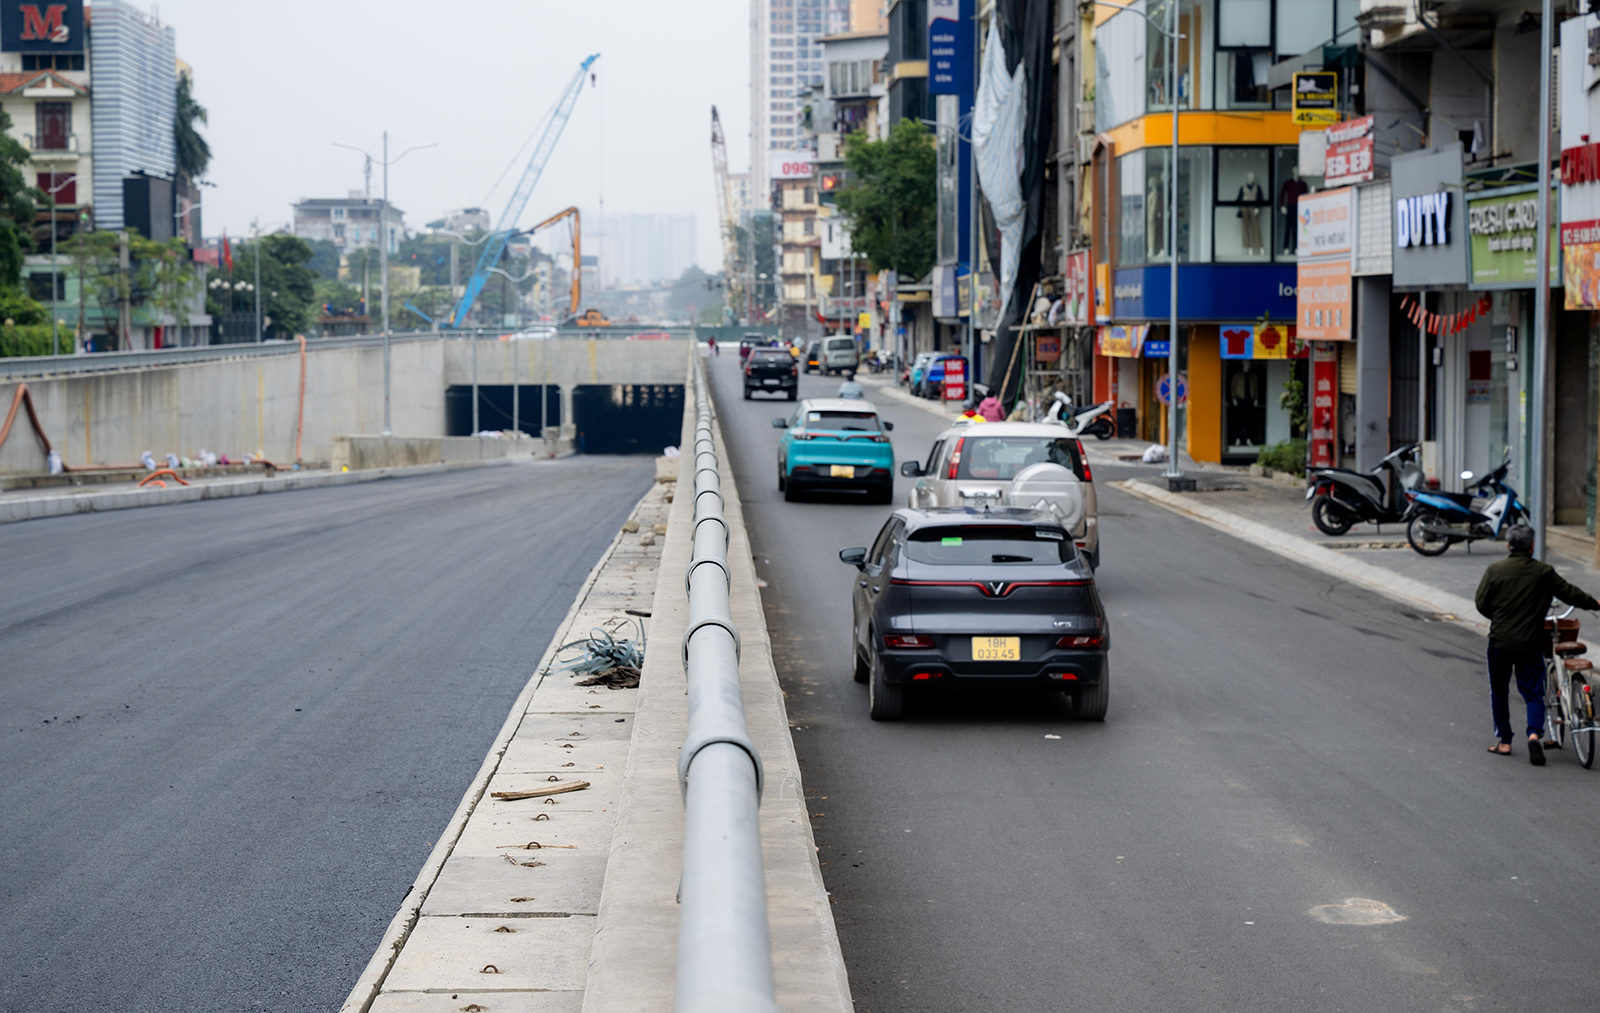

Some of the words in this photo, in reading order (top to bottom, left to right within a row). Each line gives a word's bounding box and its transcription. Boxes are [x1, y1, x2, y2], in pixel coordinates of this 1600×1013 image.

[1396, 191, 1448, 248] DUTY
[1469, 203, 1504, 235] FRESH
[1278, 282, 1297, 297] lo
[987, 637, 1007, 648] 18H
[977, 648, 1015, 659] 033.45
